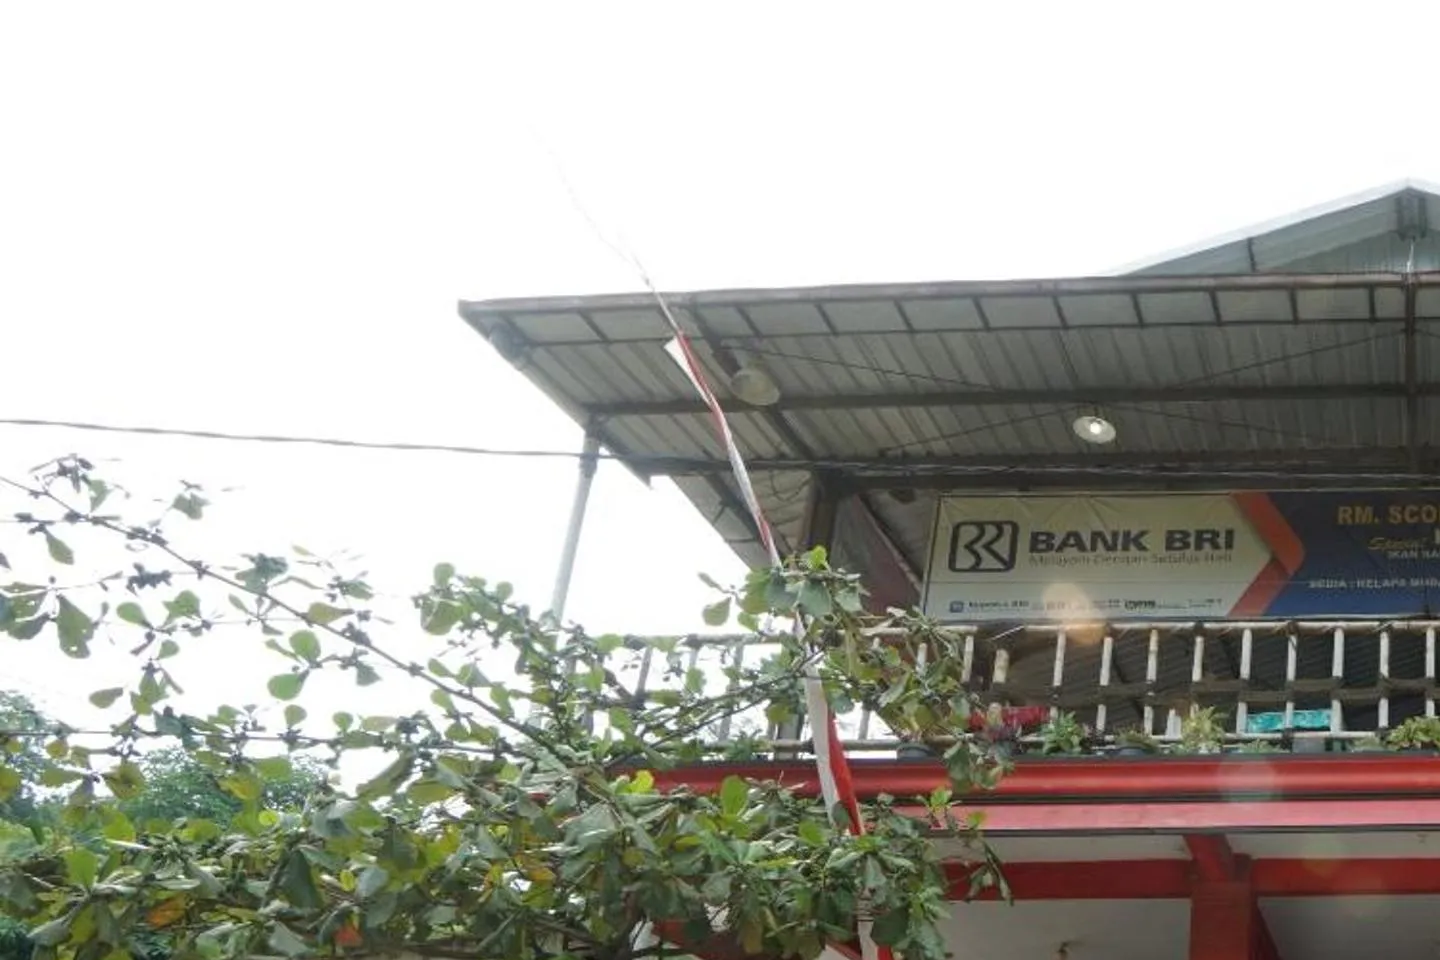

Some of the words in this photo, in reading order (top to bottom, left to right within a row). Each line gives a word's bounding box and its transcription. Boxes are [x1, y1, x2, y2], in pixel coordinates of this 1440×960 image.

[1338, 506, 1379, 525] RM.
[1028, 530, 1151, 555] BANK
[1165, 529, 1235, 552] BRI
